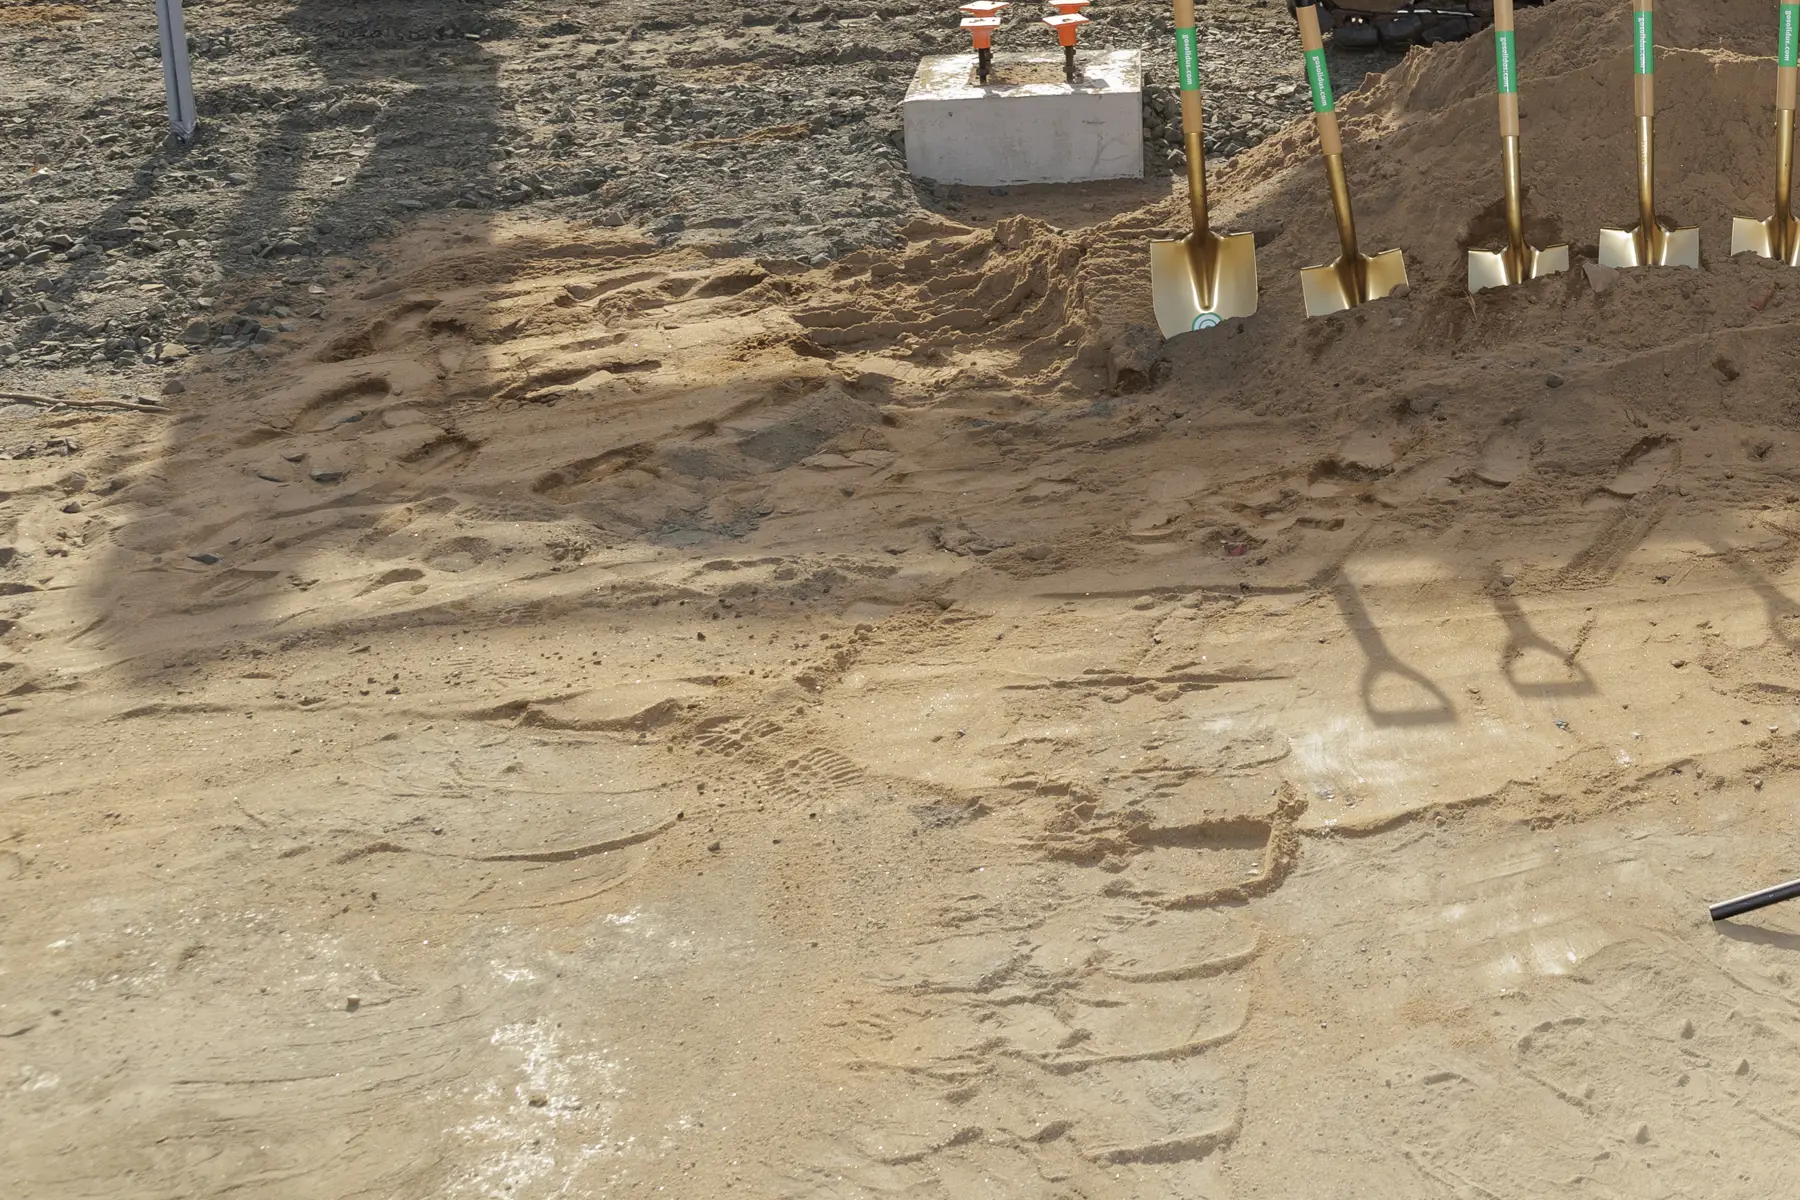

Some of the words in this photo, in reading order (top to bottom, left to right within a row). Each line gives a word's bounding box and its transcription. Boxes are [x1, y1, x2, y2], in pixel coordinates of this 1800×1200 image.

[1181, 34, 1193, 86] gosolidus.com
[1783, 10, 1793, 62] gosolidus.com
[1311, 55, 1328, 107] gosolidus.com
